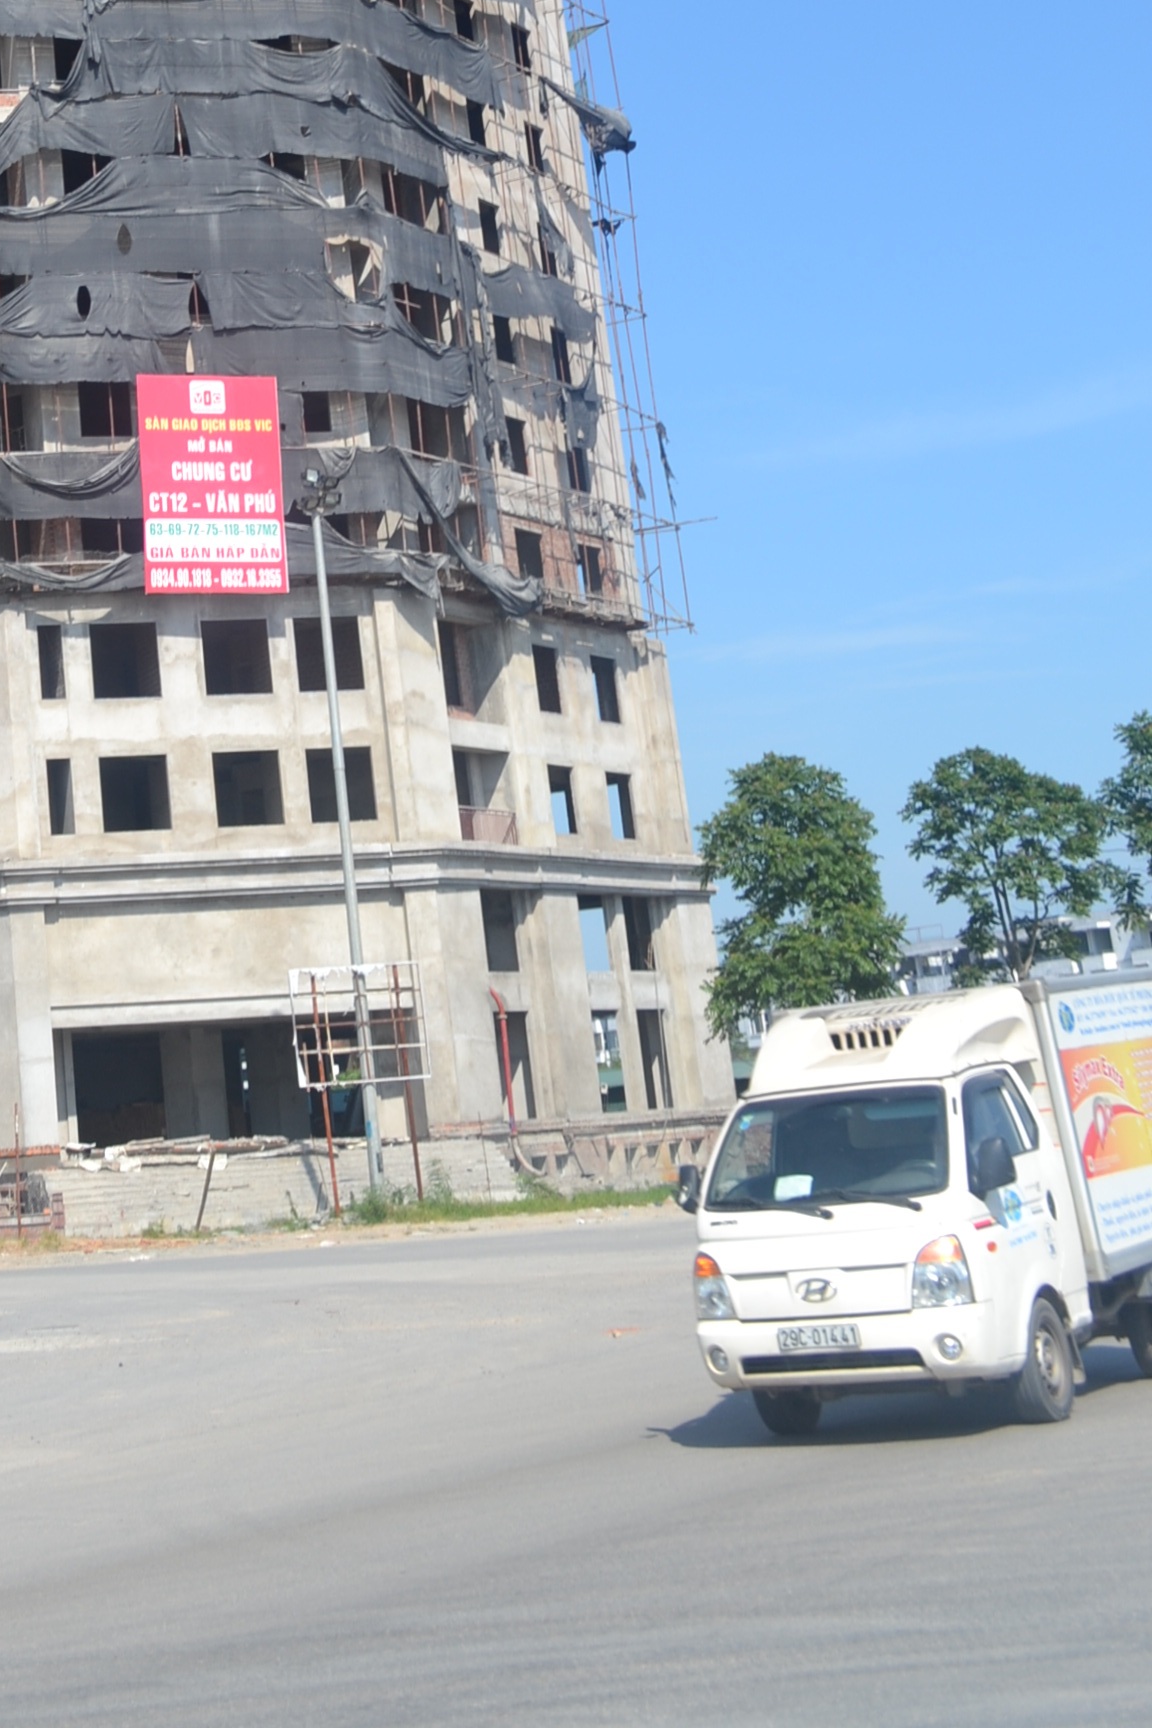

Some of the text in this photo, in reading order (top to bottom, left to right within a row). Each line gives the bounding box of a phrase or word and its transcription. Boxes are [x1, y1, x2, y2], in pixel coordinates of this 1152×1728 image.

[145, 415, 169, 431] SÀN
[172, 418, 198, 430] GIAO
[201, 419, 226, 434] DỊCH
[255, 419, 272, 431] VIC
[188, 436, 232, 453] MỞ BÁN
[171, 459, 253, 481] CHUNG CƯ
[149, 492, 188, 513] CT12
[205, 489, 239, 513] VĂN
[244, 489, 276, 513] PHÚ
